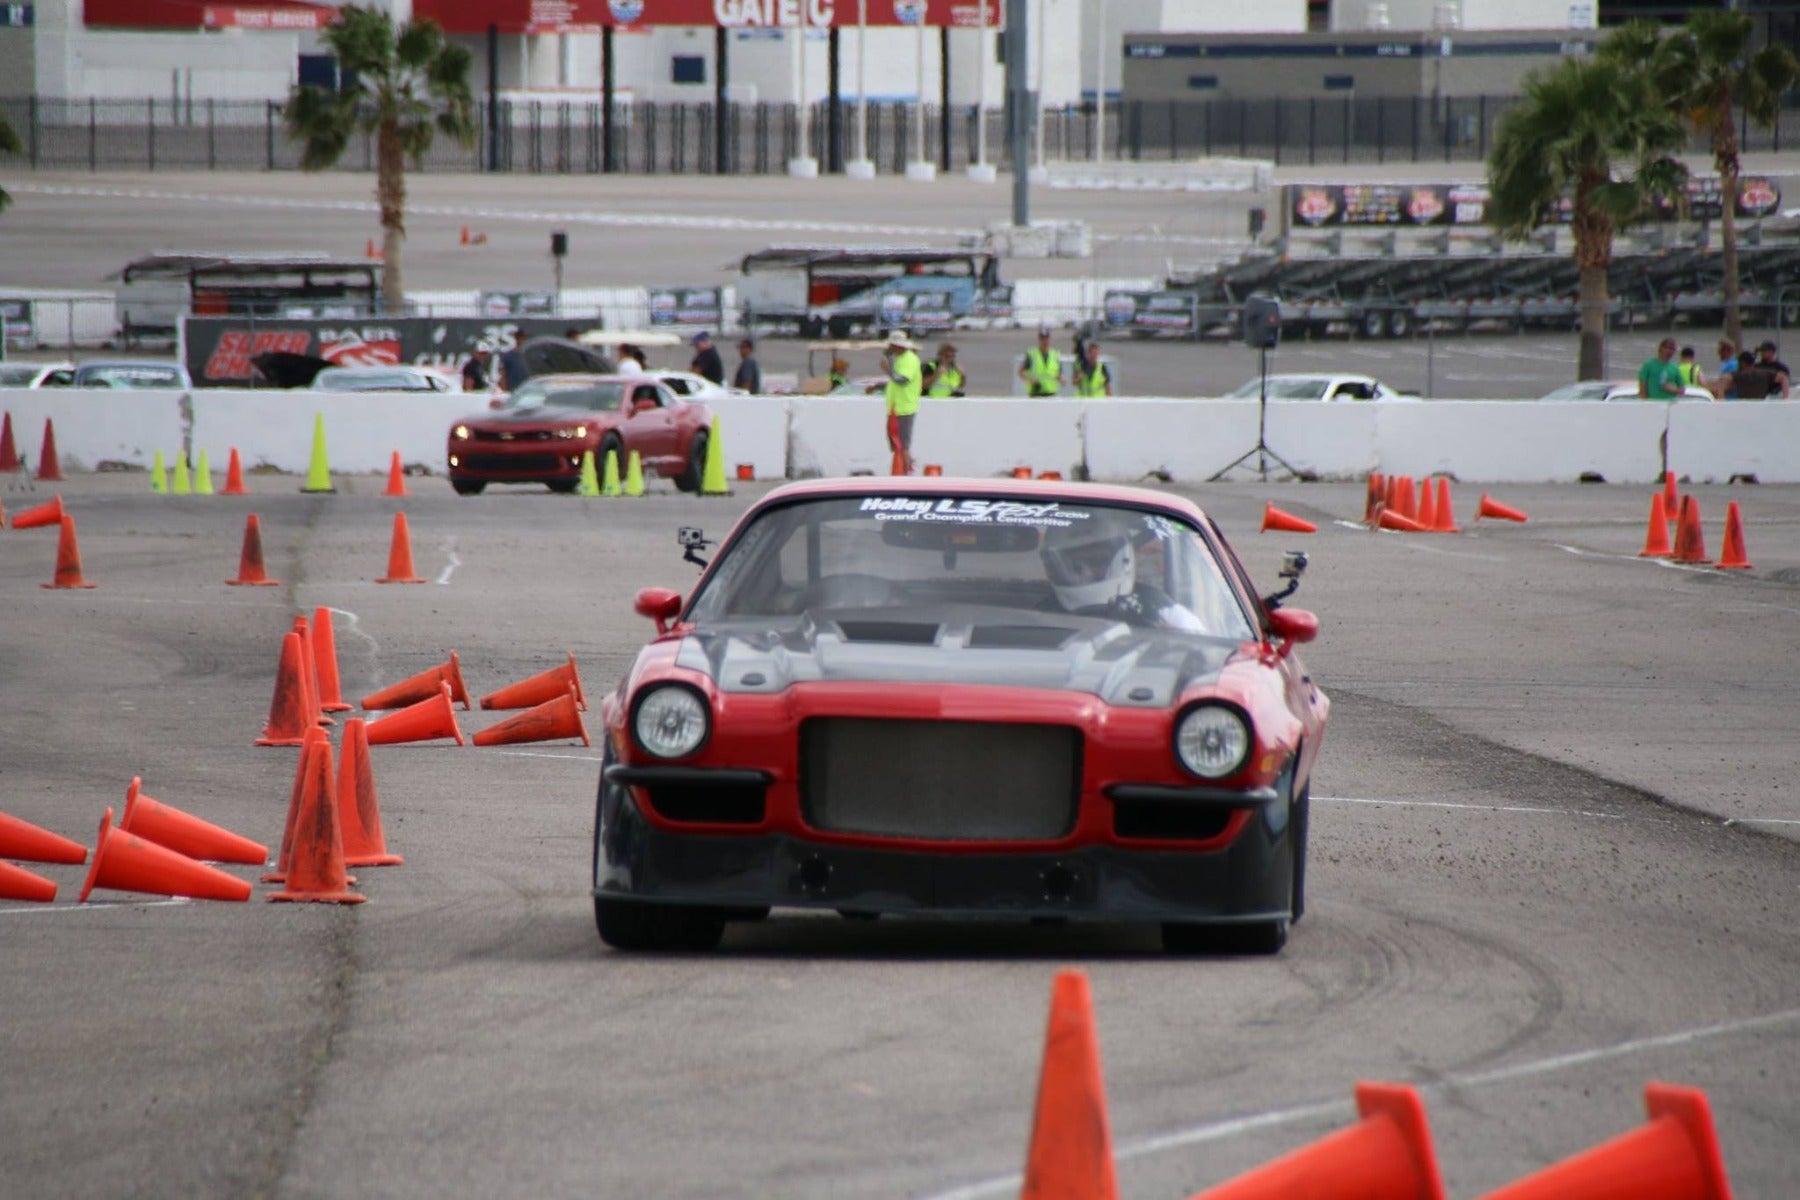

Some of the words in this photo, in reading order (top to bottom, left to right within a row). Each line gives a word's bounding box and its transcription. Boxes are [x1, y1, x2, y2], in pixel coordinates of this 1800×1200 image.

[714, 0, 801, 27] GATE
[809, 0, 835, 27] C
[318, 327, 398, 343] BAER
[859, 497, 933, 515] Holley
[874, 513, 920, 521] Grand
[922, 513, 993, 522] Champion
[997, 515, 1073, 527] Competitor
